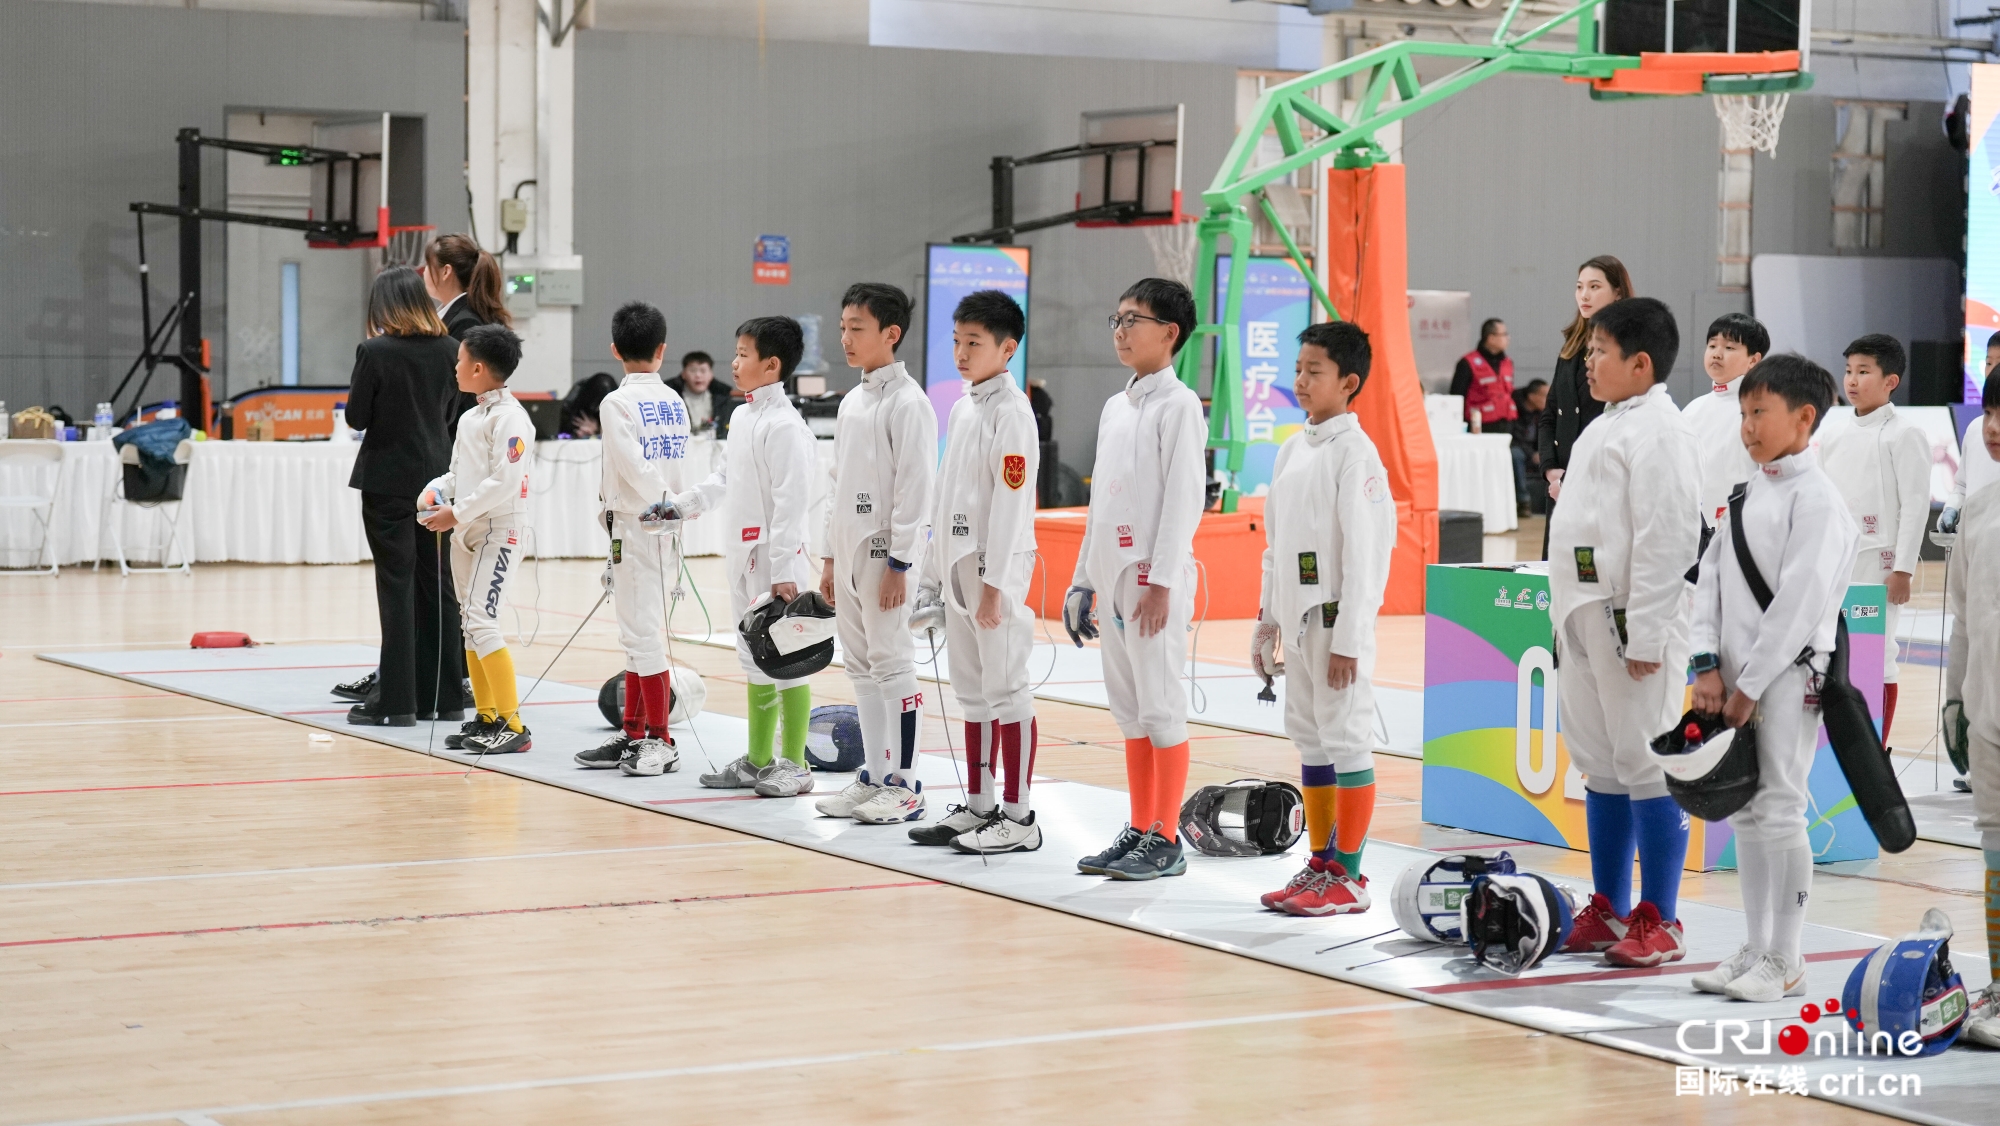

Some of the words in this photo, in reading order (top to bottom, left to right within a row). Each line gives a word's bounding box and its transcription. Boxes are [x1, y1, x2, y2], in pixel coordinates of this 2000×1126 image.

[1245, 321, 1280, 441] 医疗台
[638, 401, 686, 427] 闫鼎新
[485, 547, 511, 619] VANGO
[901, 692, 923, 712] FR
